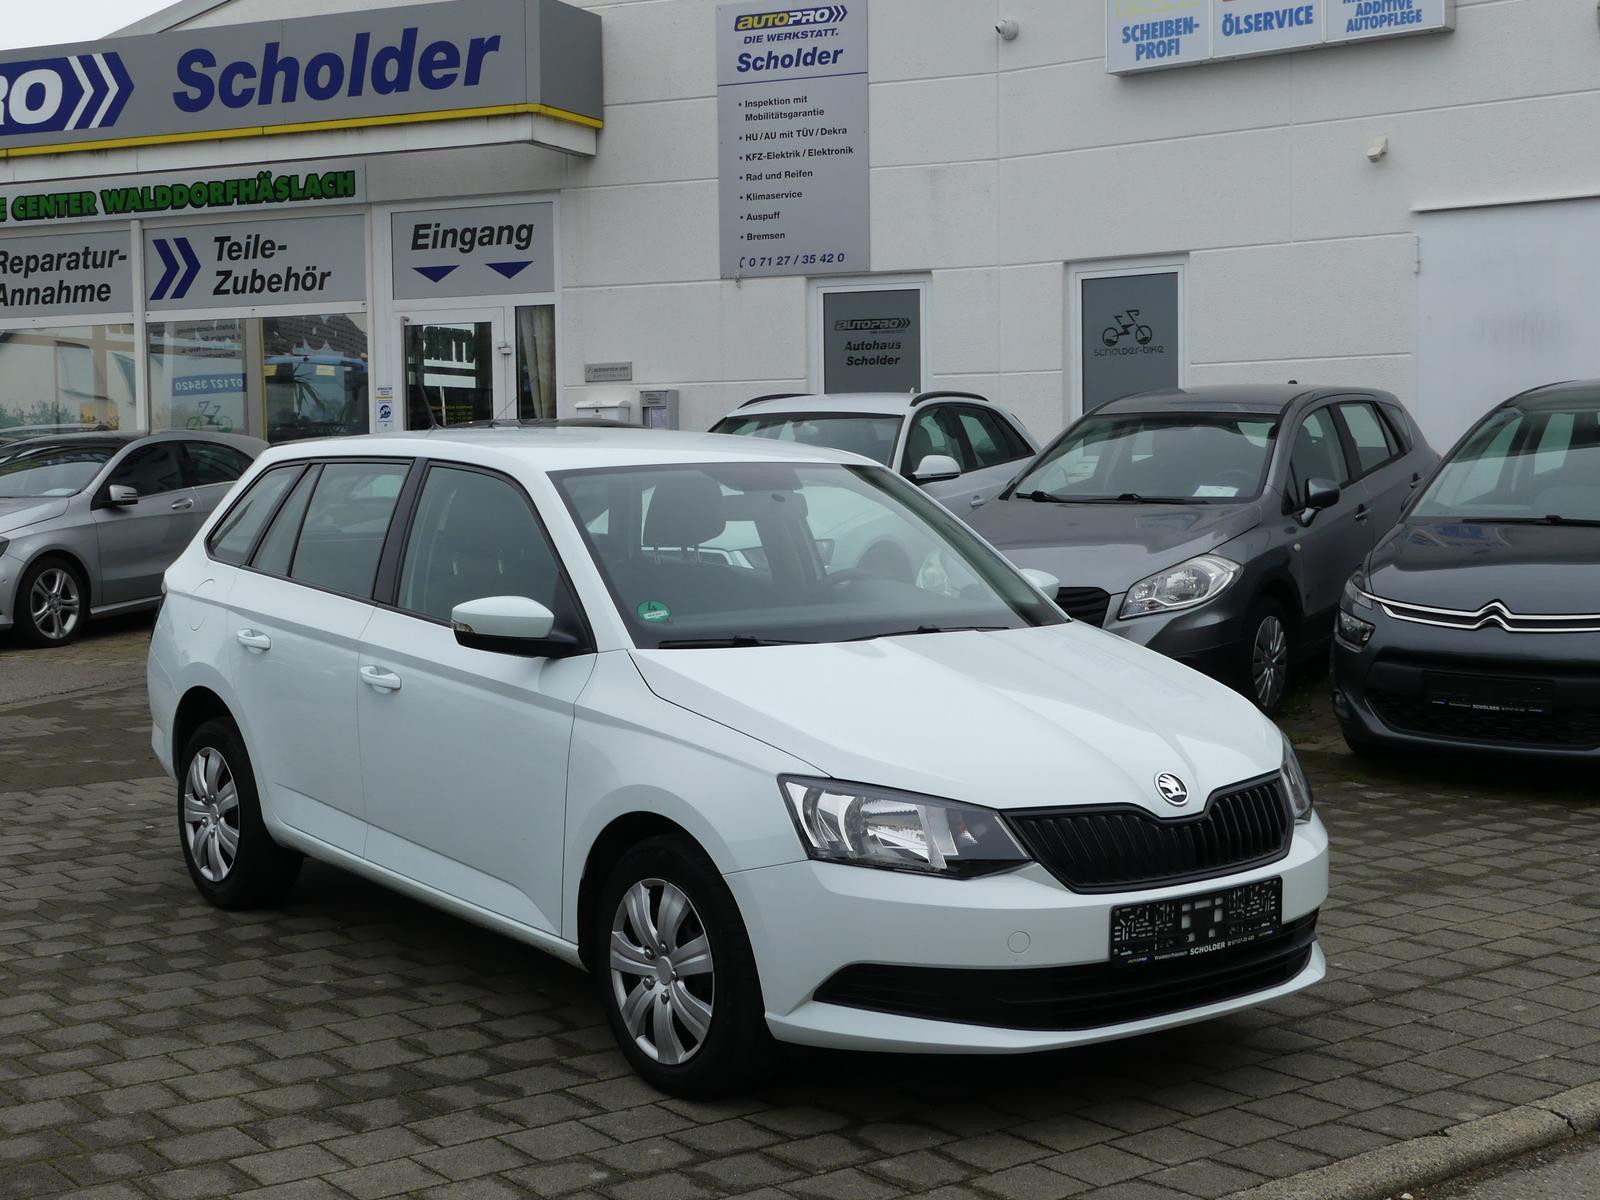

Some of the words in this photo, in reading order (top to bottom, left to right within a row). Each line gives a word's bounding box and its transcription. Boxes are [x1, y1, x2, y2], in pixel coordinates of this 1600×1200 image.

[1355, 0, 1413, 17] ADDITIVE
[1222, 5, 1313, 36] ÖLSERVICE
[1346, 9, 1423, 32] AUTOPFLEGE
[744, 35, 764, 44] DIE
[767, 28, 839, 42] WERKSTATT.
[1122, 16, 1200, 44] SCHEIBEN-
[1136, 39, 1180, 61] PROFI
[736, 47, 844, 72] Scholder
[172, 27, 501, 113] Scholder
[745, 98, 791, 108] Inspektion
[793, 96, 808, 104] mit
[745, 108, 825, 121] Mobilitätsgarantie
[780, 130, 794, 139] mit
[745, 149, 801, 161] KFZ-Elektrik
[808, 146, 854, 157] Elektronik
[746, 173, 763, 181] Rad
[765, 172, 782, 180] und
[784, 170, 813, 179] Reifen
[11, 191, 98, 222] CENTER
[100, 171, 356, 215] WALDDORFHÄSLACH
[746, 190, 803, 201] Klimaservice
[746, 211, 780, 221] Auspuff
[410, 222, 535, 253] Eingang
[746, 232, 786, 241] Bremsen
[213, 234, 288, 262] Teile-
[213, 266, 331, 296] Zubehör
[844, 340, 902, 351] Autohaus
[846, 355, 902, 366] Scholder
[1190, 941, 1226, 956] SCHOLDER
